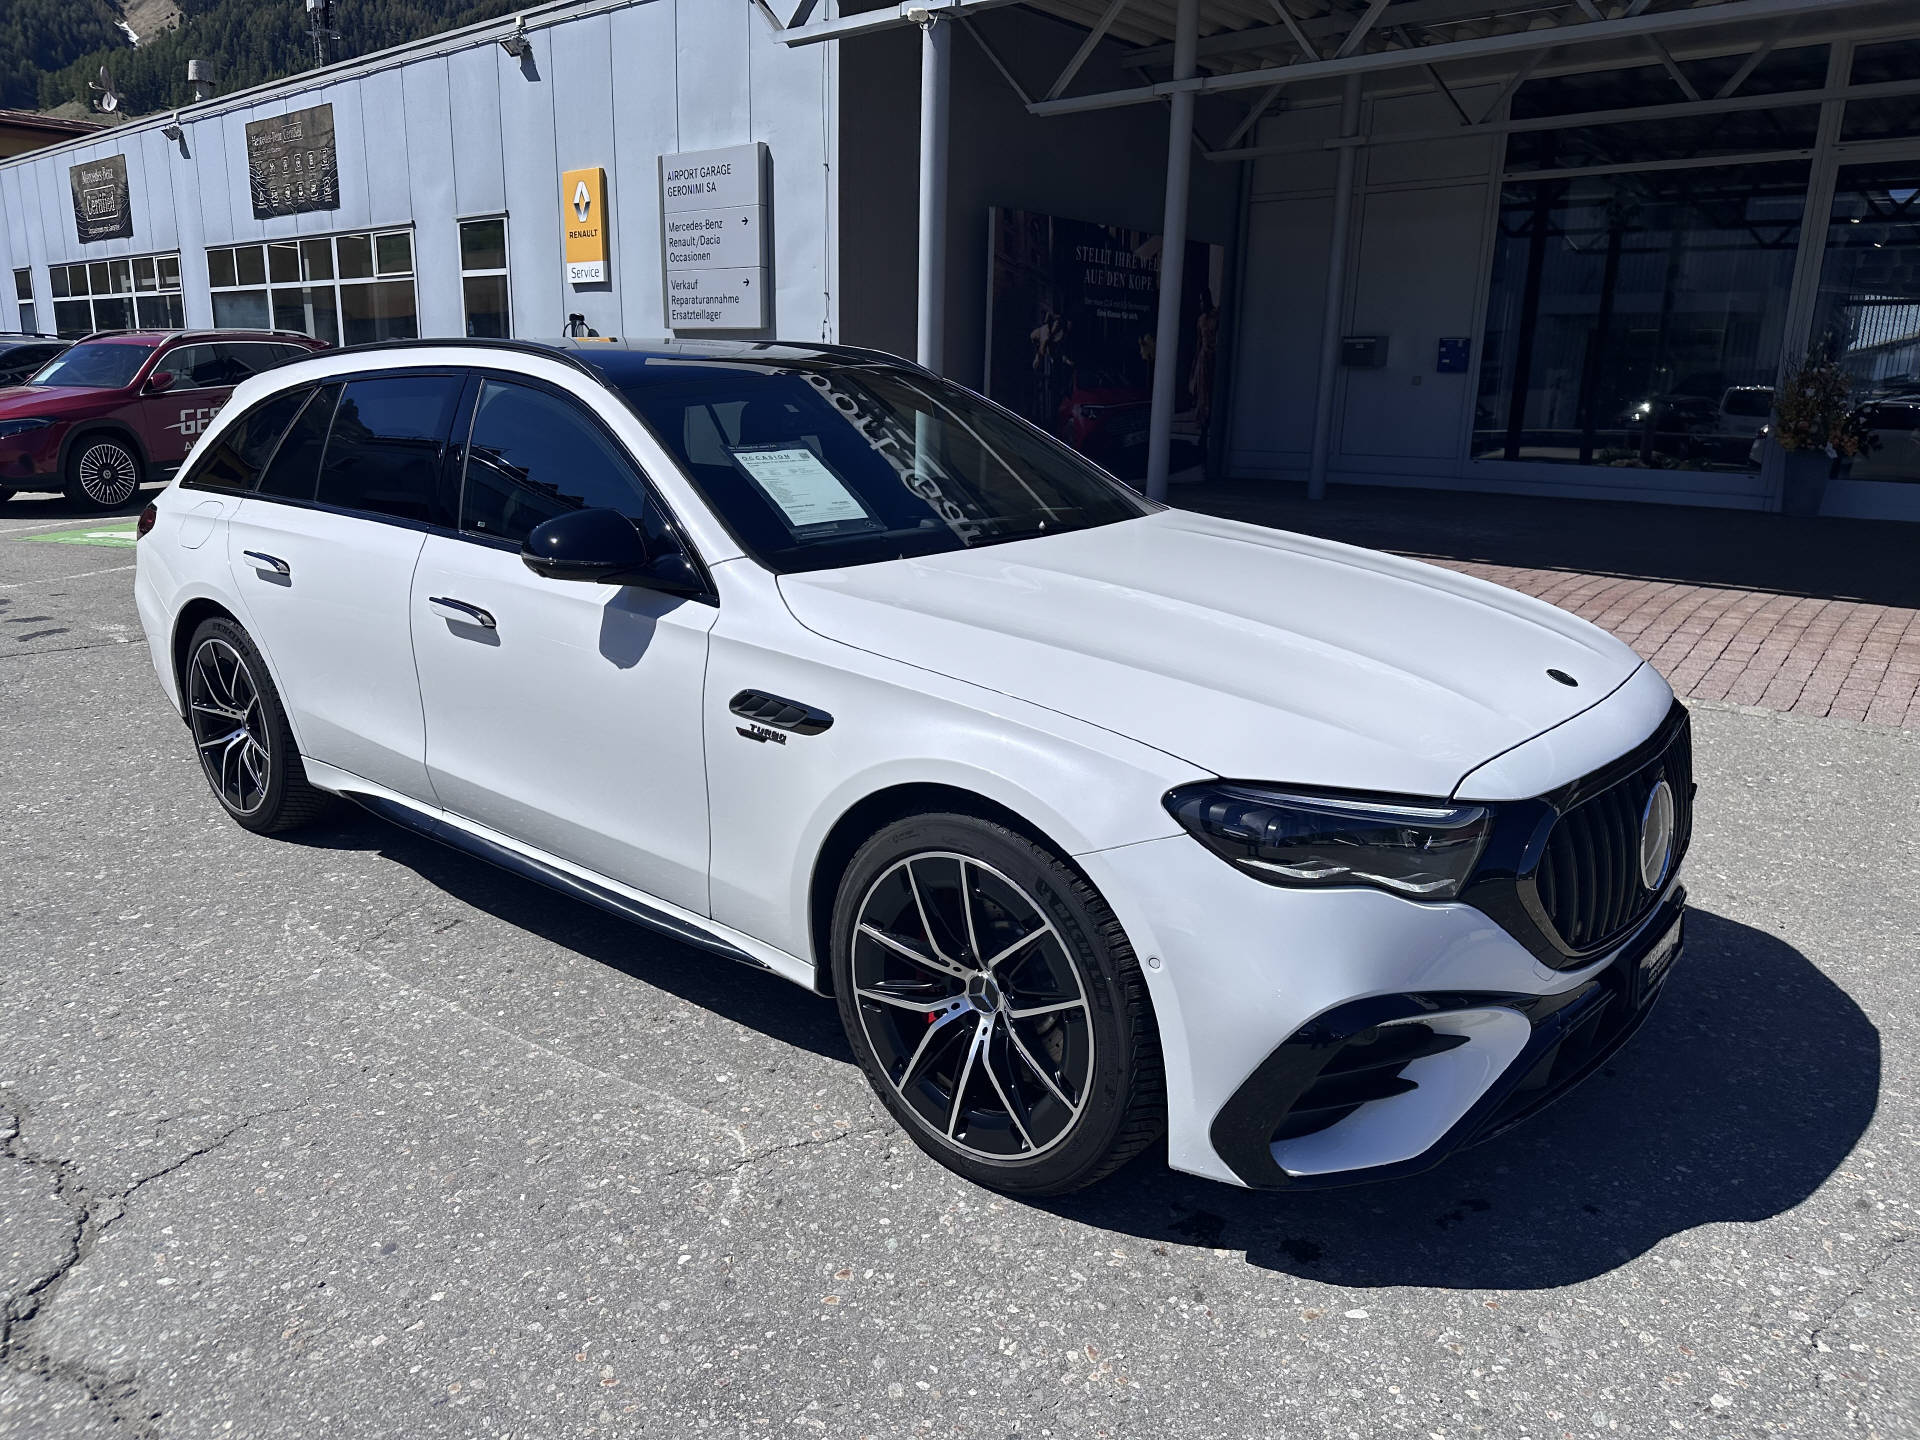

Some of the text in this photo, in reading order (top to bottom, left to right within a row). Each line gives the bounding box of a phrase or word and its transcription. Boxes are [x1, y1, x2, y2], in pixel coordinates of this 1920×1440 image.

[667, 163, 732, 181] AIRPORT GARAGE
[667, 181, 717, 197] GERONIMI SA
[669, 218, 723, 232] Mercedes-Benz
[569, 229, 599, 239] RENAULT
[669, 236, 721, 248] Renault/Dacia
[669, 250, 711, 263] Occasionen
[1076, 246, 1160, 272] STELLT IHRE WEL
[571, 266, 600, 278] Service
[1084, 268, 1104, 286] AUF
[1106, 271, 1126, 288] DEN
[671, 279, 698, 291] Verkauf
[671, 293, 740, 307] Reparaturannahme
[672, 307, 722, 321] Ersatzteillager
